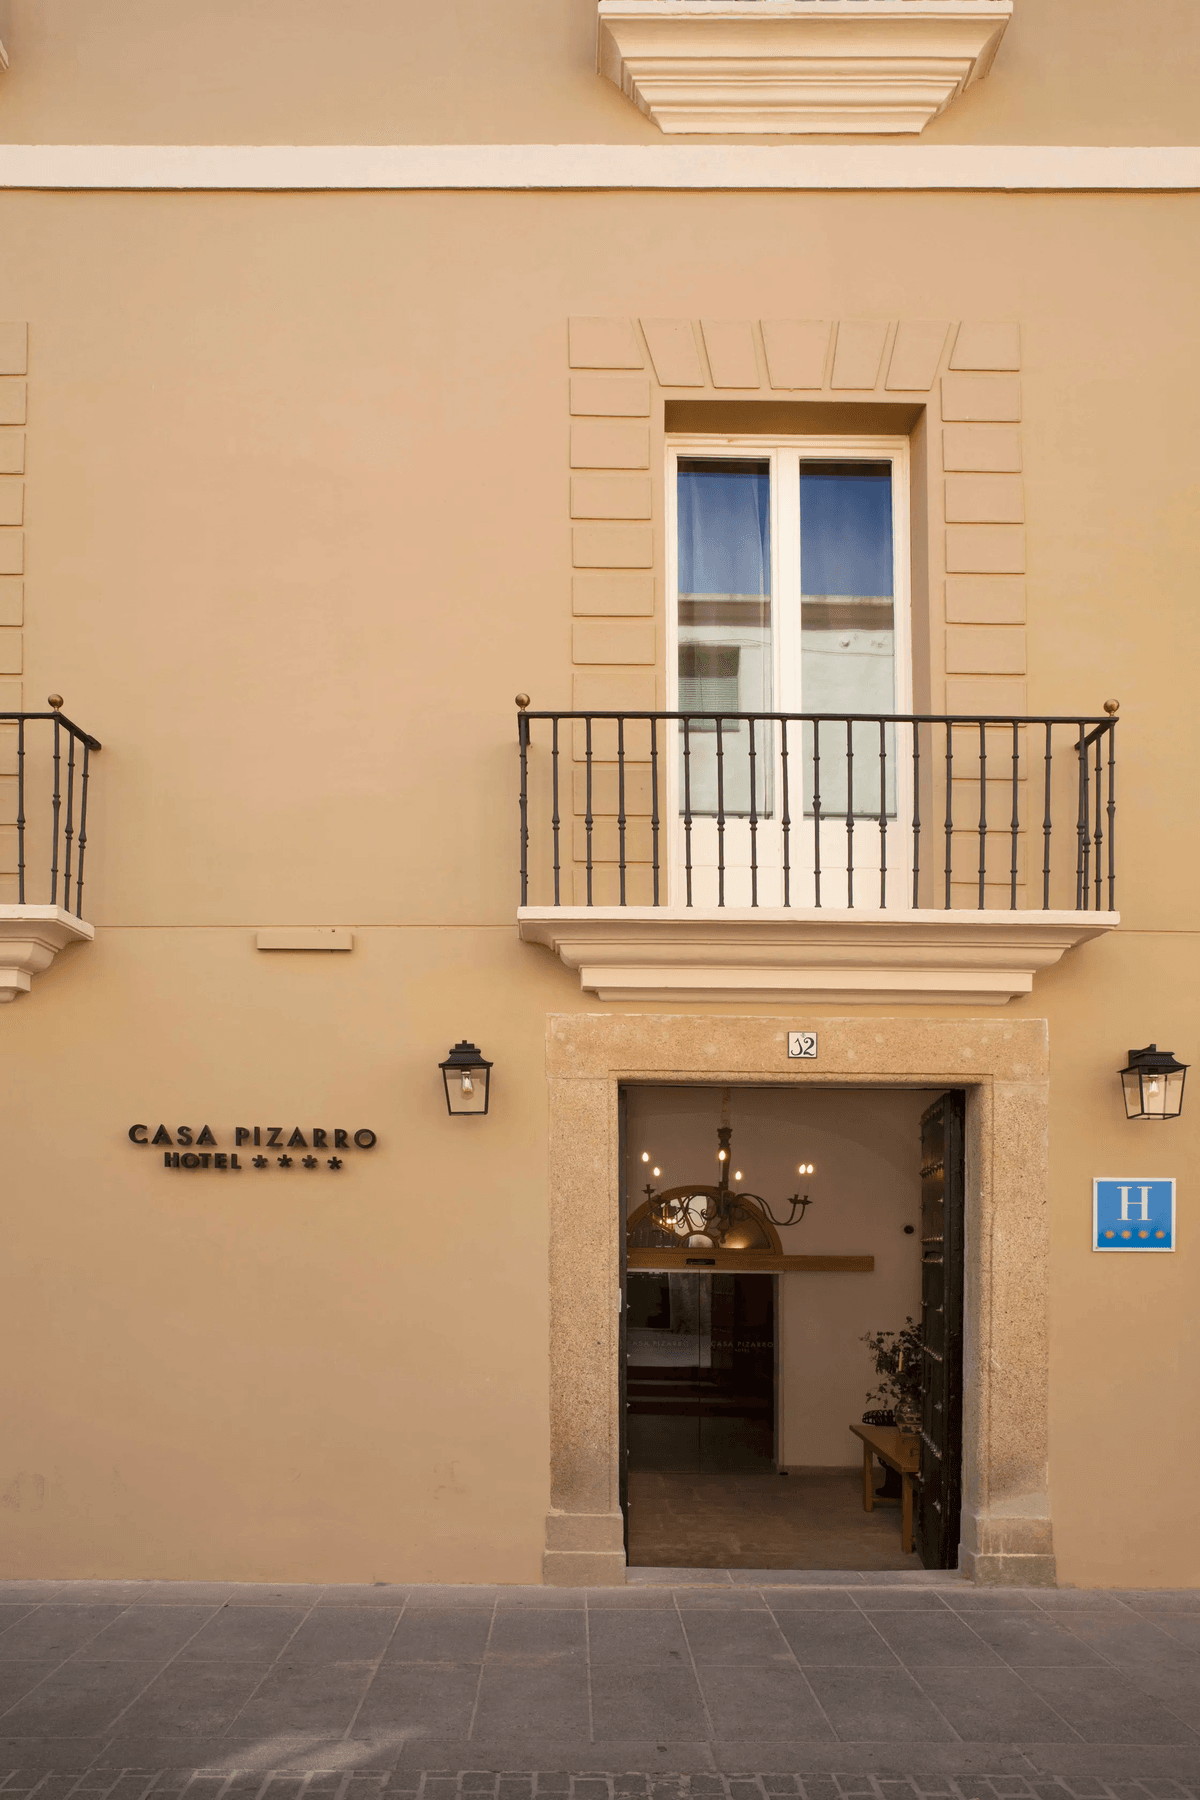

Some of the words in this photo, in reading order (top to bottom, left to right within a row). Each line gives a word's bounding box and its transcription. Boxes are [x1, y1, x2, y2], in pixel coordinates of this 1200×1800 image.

[128, 1123, 218, 1146] CASA
[235, 1126, 378, 1150] PIZARRO
[163, 1151, 243, 1170] HOTEL
[1116, 1185, 1153, 1221] H
[710, 1340, 734, 1348] CASA
